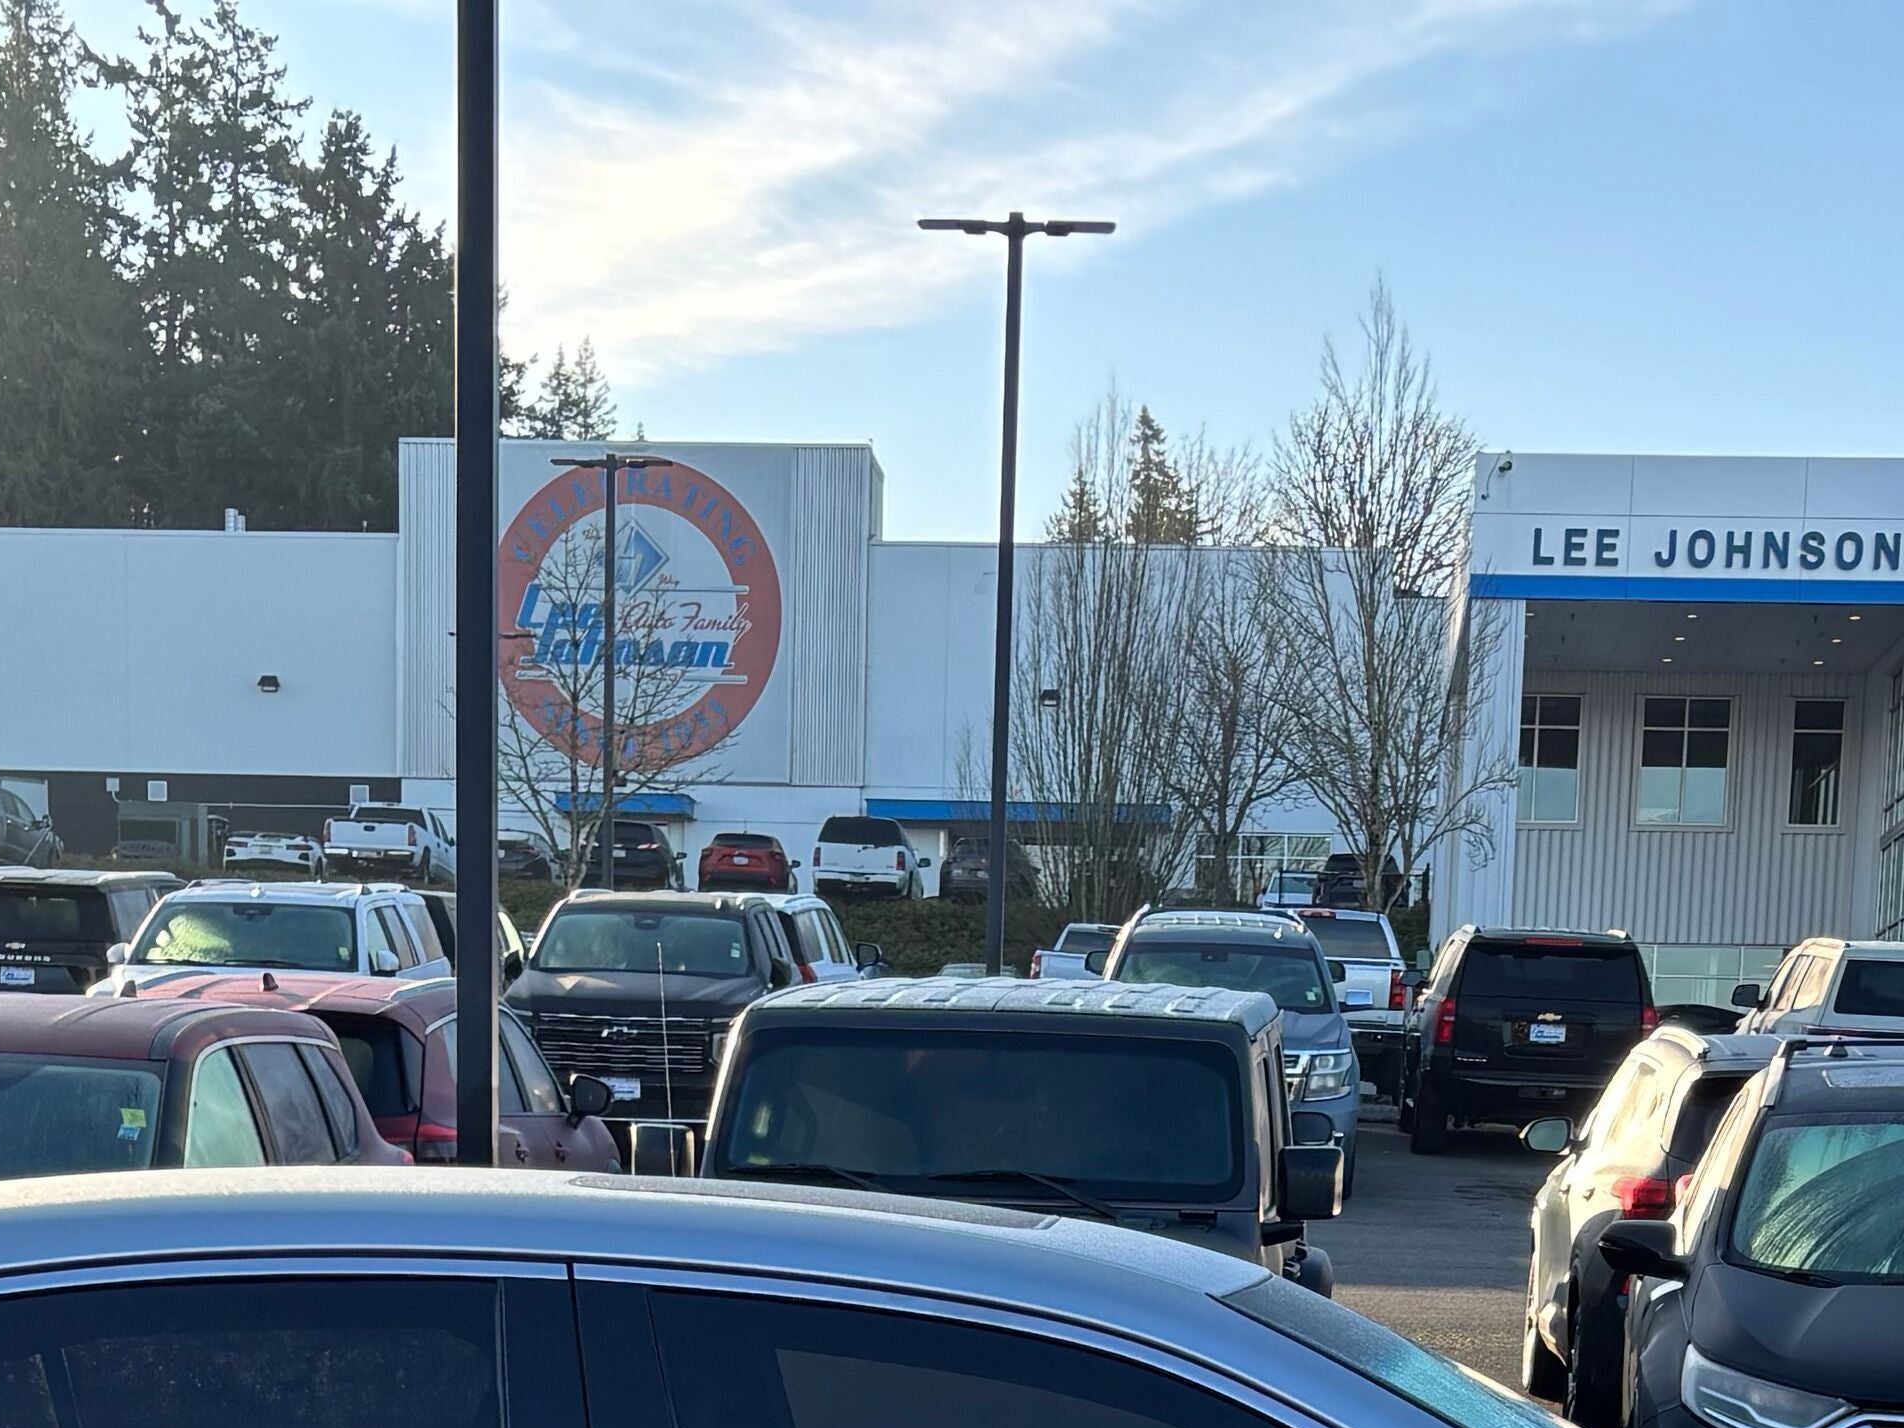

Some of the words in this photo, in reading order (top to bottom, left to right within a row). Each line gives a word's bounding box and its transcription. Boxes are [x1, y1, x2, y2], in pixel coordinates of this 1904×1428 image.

[1532, 527, 1621, 567] LEE
[1654, 529, 1902, 571] JOHNSON
[515, 583, 607, 629] Lee
[678, 601, 752, 646] Family
